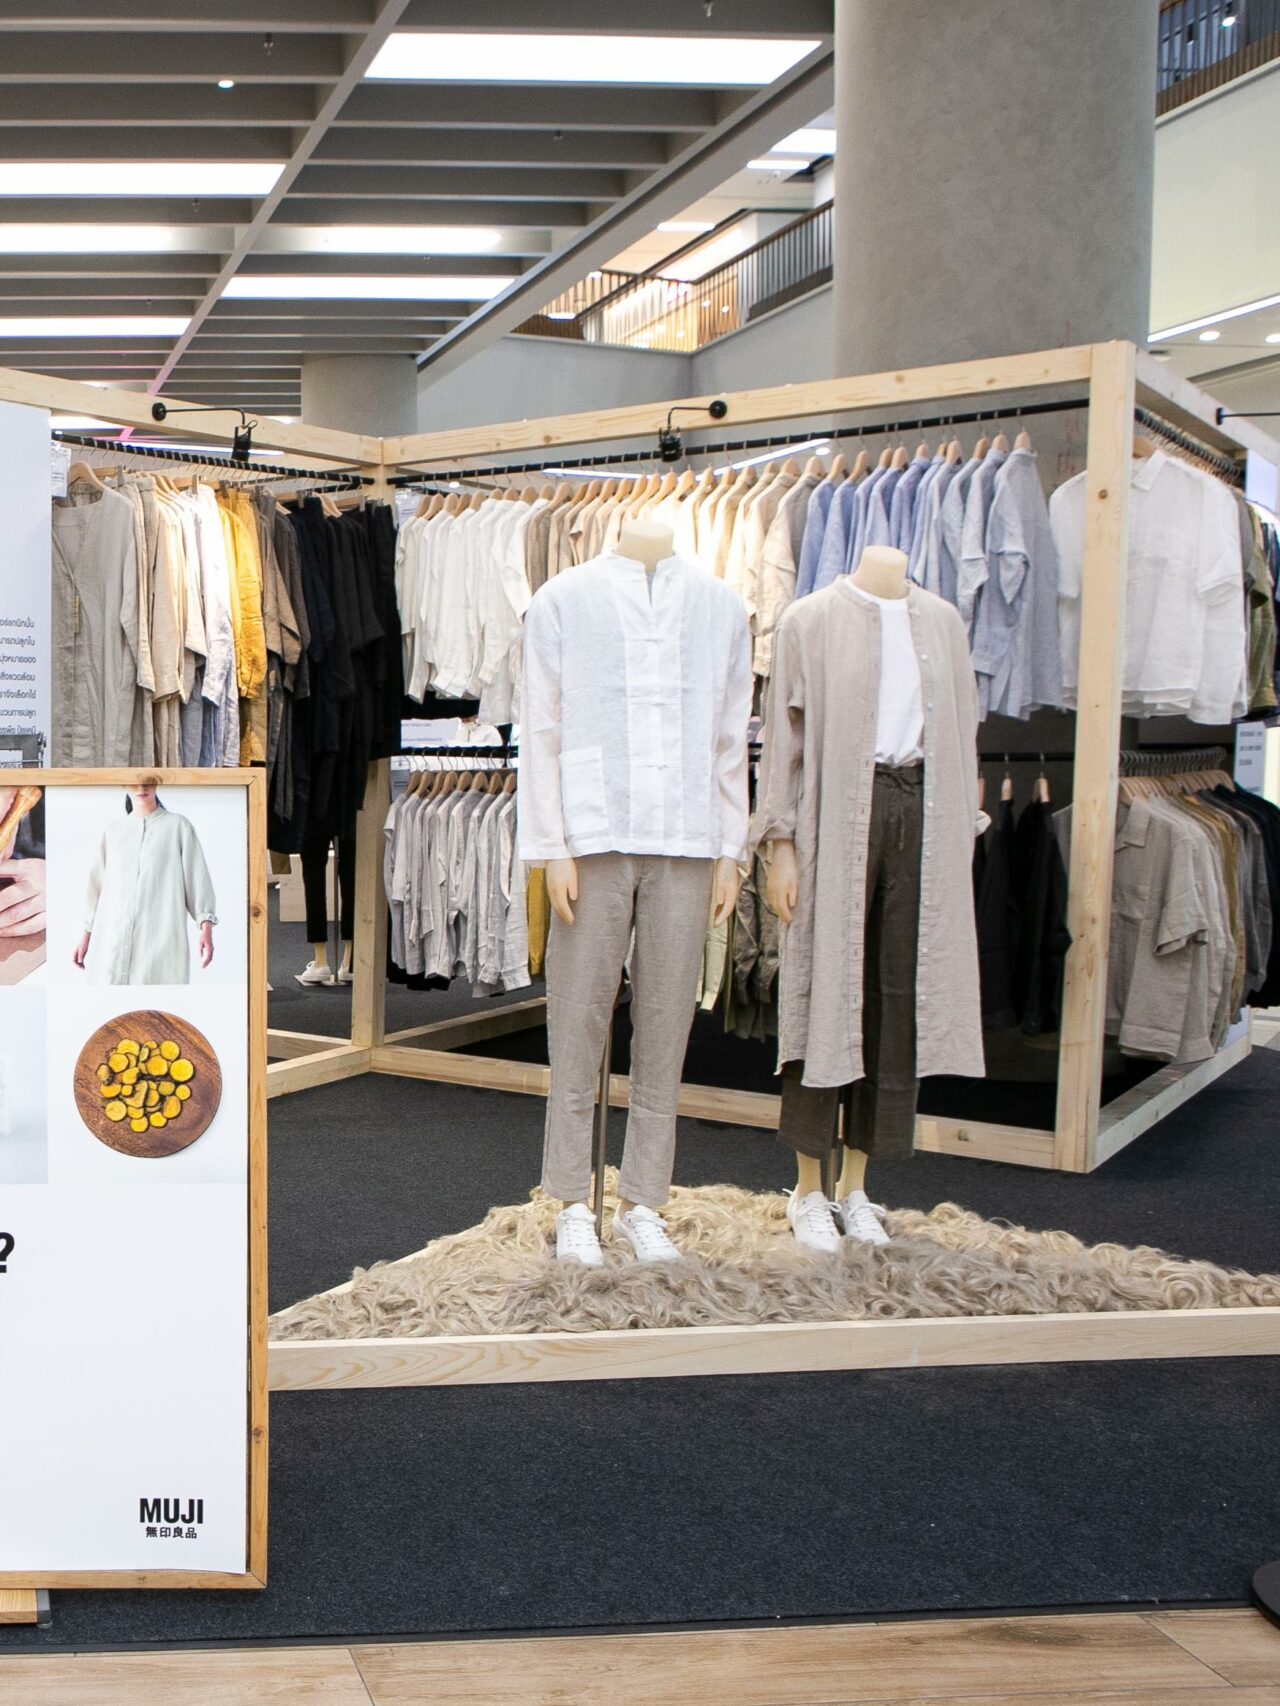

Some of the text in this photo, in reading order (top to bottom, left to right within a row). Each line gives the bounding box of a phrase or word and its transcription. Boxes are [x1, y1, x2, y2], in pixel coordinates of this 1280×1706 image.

[140, 1498, 203, 1524] MUJI
[146, 1527, 197, 1538] 無印良品
